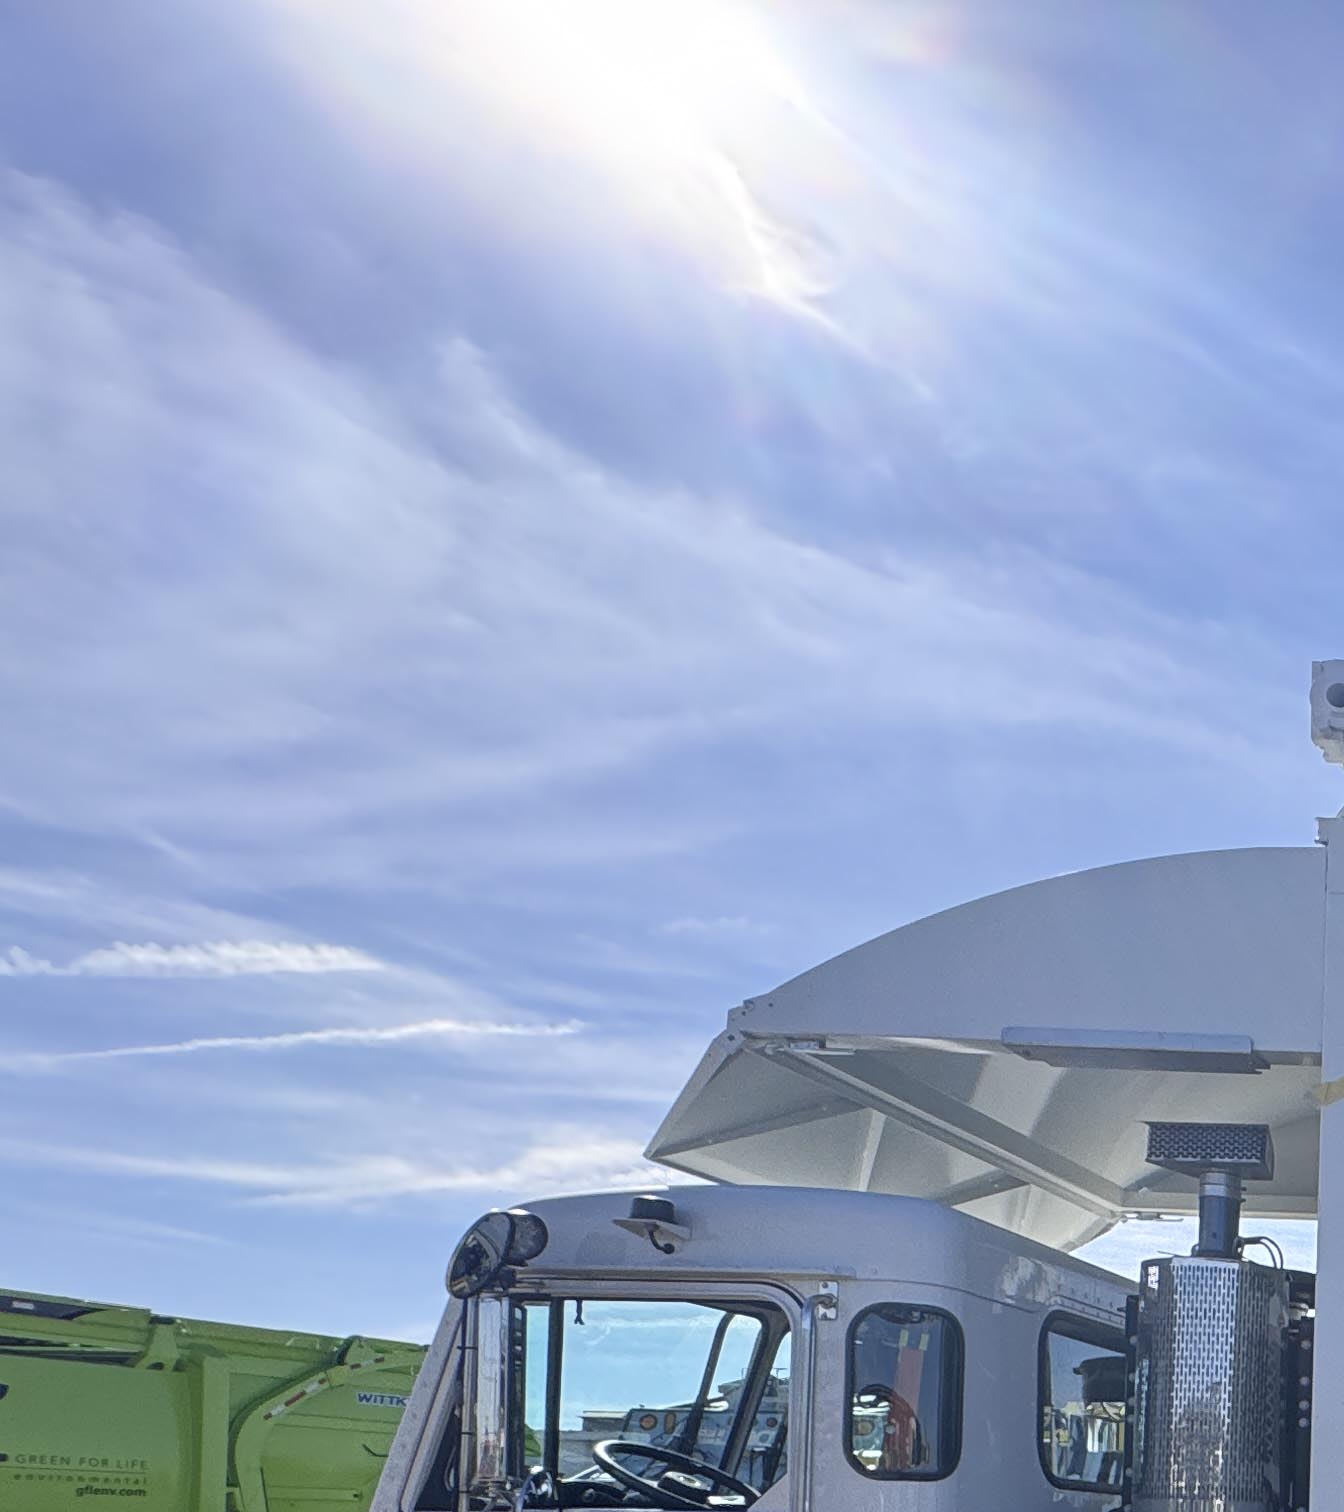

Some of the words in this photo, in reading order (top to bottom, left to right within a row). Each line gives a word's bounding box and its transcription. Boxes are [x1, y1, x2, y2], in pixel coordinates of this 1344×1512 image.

[357, 1393, 408, 1406] WITTK
[15, 1454, 71, 1465] GREEN
[79, 1457, 109, 1467] FOR
[116, 1459, 148, 1470] LIFE
[14, 1474, 147, 1484] environmental
[75, 1485, 147, 1497] gflenv.com
